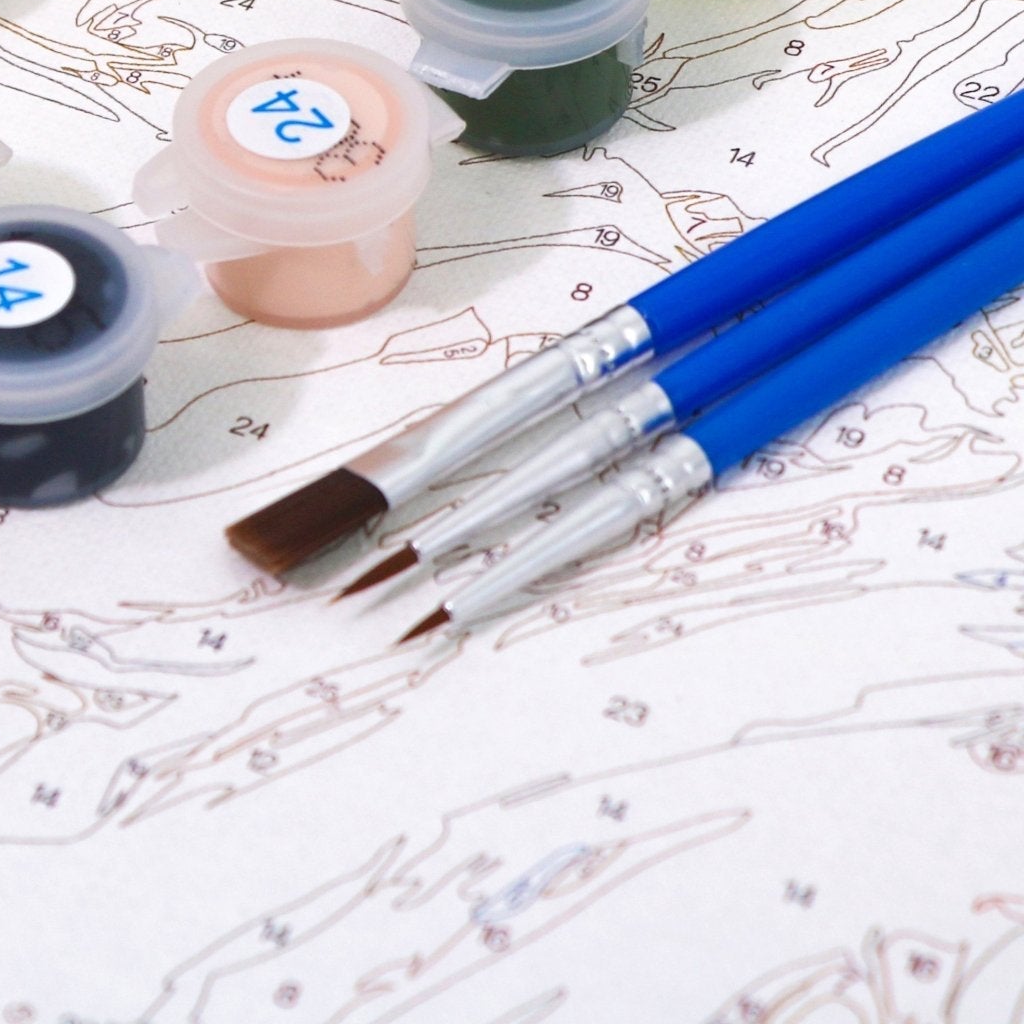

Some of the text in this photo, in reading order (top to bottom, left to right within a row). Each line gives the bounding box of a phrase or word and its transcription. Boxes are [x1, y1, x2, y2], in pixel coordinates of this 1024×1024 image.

[113, 12, 129, 24] 7
[107, 29, 121, 41] 8
[158, 44, 173, 58] 18
[219, 38, 236, 52] 19
[784, 40, 805, 56] 8
[126, 71, 141, 84] 8
[821, 64, 834, 74] 7
[959, 81, 1000, 104] 22
[252, 90, 333, 143] 24
[730, 148, 755, 167] 14
[600, 184, 619, 198] 19
[687, 217, 707, 233] 7
[594, 229, 621, 247] 19
[571, 283, 592, 301] 8
[229, 416, 269, 440] 24
[836, 426, 865, 448] 19
[883, 465, 906, 485] 8
[919, 529, 946, 550] 14
[199, 629, 226, 650] 14
